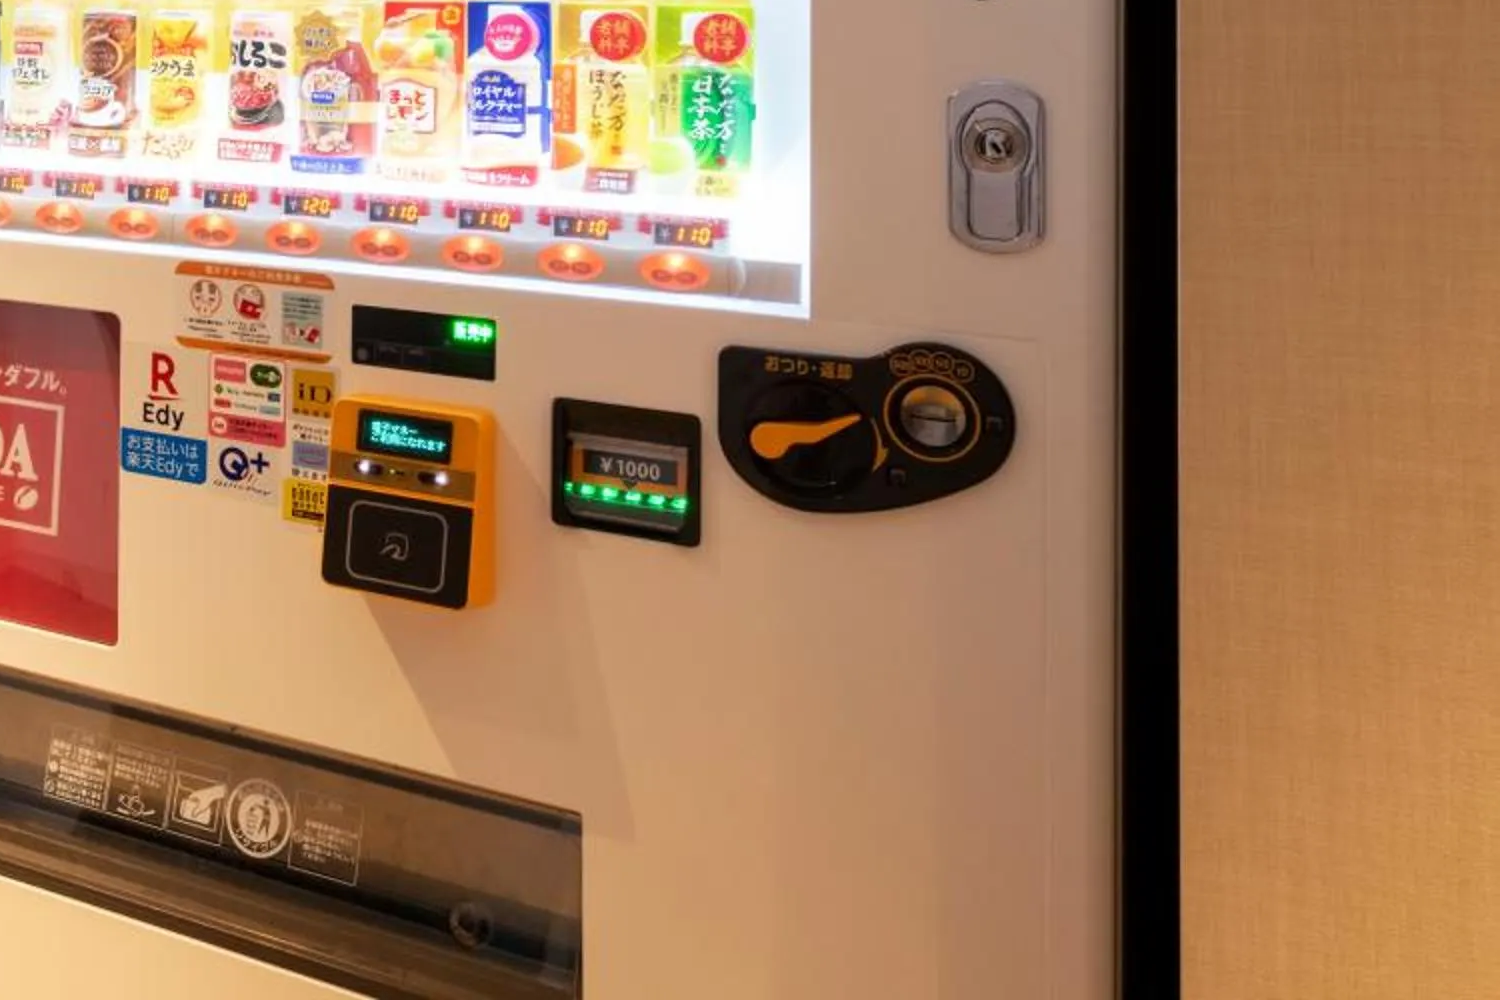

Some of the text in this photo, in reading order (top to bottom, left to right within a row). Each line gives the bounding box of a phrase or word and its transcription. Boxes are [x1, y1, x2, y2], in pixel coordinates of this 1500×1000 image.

[150, 351, 179, 396] R
[298, 383, 332, 403] iD
[143, 402, 185, 431] Edy
[127, 435, 198, 459] お支払いは
[126, 450, 199, 479] 楽天Edyで
[600, 455, 661, 482] ¥1000
